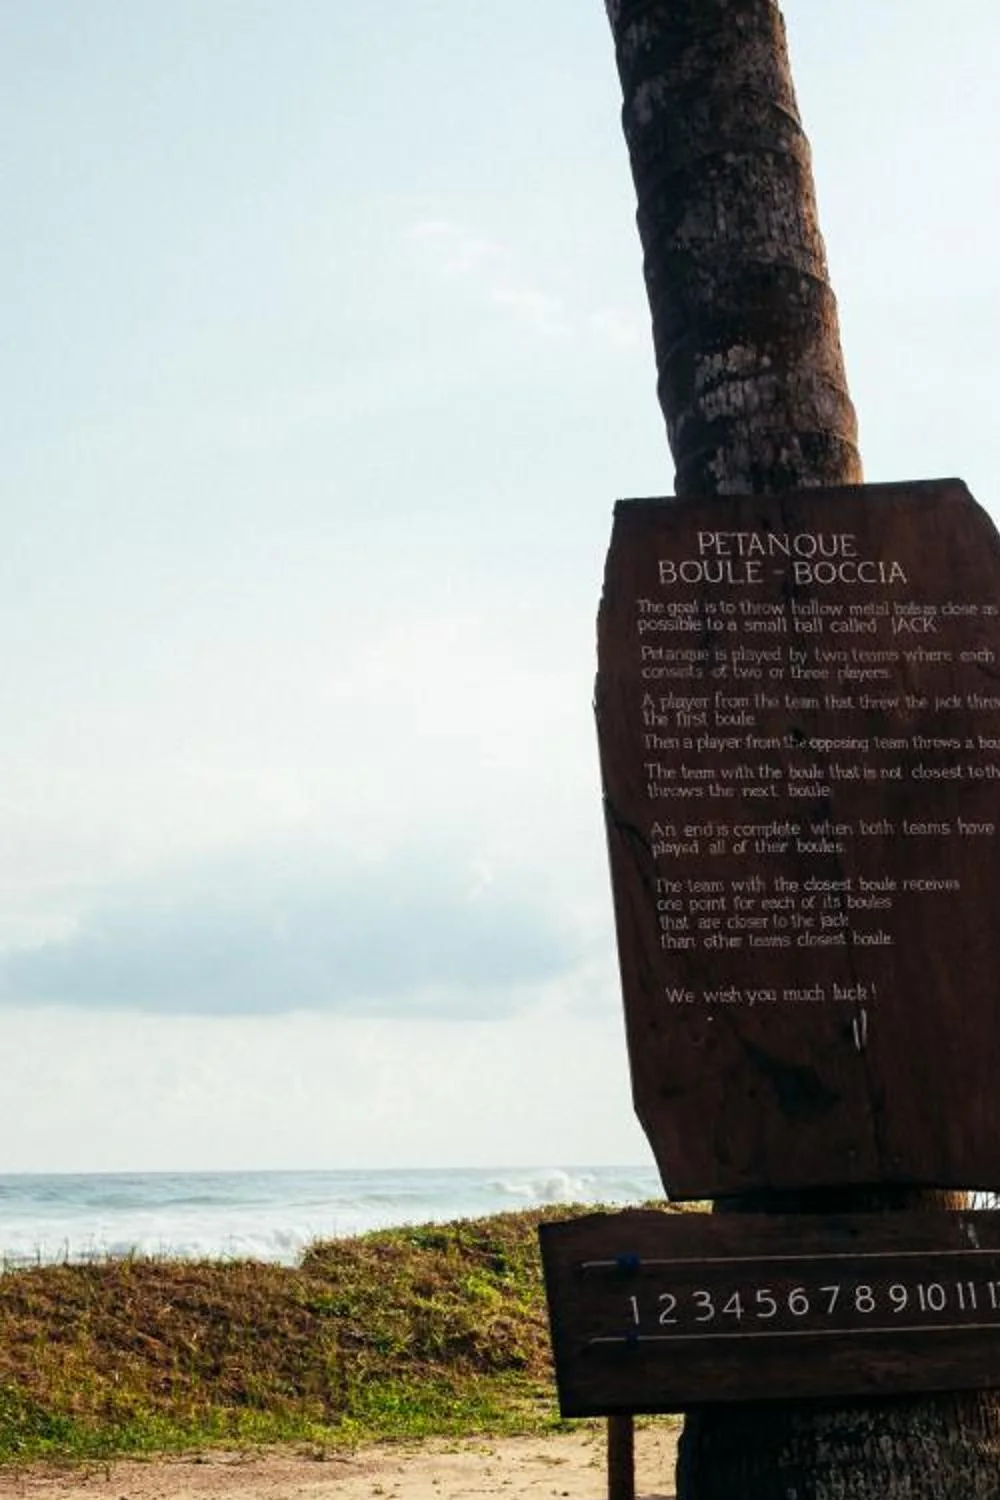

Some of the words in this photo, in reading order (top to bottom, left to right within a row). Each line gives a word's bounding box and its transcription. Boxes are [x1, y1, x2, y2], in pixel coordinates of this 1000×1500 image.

[697, 532, 860, 558] PETANQUE
[658, 560, 763, 584] BOULE
[793, 559, 907, 585] BOCCIA
[636, 599, 665, 613] The
[667, 599, 698, 617] goal
[705, 600, 717, 613] is
[720, 600, 737, 614] to
[739, 599, 784, 615] throw
[791, 598, 844, 616] hollow
[850, 601, 889, 616] metal
[941, 601, 978, 615] close
[636, 616, 701, 635] possible
[707, 616, 724, 632] to
[726, 620, 738, 632] a
[744, 617, 787, 633] small
[794, 617, 823, 633] ball
[829, 617, 877, 633] called
[641, 646, 709, 662] Petanque
[715, 647, 728, 661] is
[731, 645, 781, 665] played
[789, 646, 807, 665] by
[815, 647, 848, 662] two
[851, 648, 899, 662] teams
[903, 645, 953, 662] where
[960, 647, 996, 663] each
[712, 664, 729, 679] of
[733, 664, 763, 679] two
[769, 667, 784, 679] or
[791, 665, 829, 679] three
[640, 693, 655, 708] A
[660, 692, 709, 713] player
[715, 692, 749, 708] from
[754, 692, 780, 709] the
[785, 693, 820, 709] team
[825, 693, 855, 709] that
[859, 694, 899, 709] threw
[905, 694, 929, 709] the
[934, 694, 962, 713] jack
[642, 709, 669, 726] the
[676, 709, 708, 727] first
[643, 734, 679, 749] Then
[683, 737, 692, 749] a
[697, 732, 743, 752] player
[747, 733, 781, 749] from
[809, 735, 869, 752] opposing
[873, 736, 909, 749] team
[912, 736, 961, 749] throws
[965, 738, 975, 749] a
[643, 763, 677, 779] The
[681, 764, 715, 779] team
[720, 763, 754, 779] with
[759, 763, 783, 779] the
[788, 763, 824, 779] boule
[828, 763, 860, 780] that
[863, 764, 877, 779] is
[880, 766, 902, 779] not
[911, 763, 963, 780] closest
[967, 764, 984, 779] to
[647, 782, 703, 798] throws
[708, 783, 734, 797] the
[742, 784, 779, 797] next
[651, 820, 677, 837] An
[684, 820, 714, 837] end
[717, 823, 729, 837] is
[733, 820, 800, 839] complete
[810, 819, 852, 836] when
[859, 819, 894, 835] both
[903, 819, 950, 835] teams
[957, 816, 995, 836] have
[651, 840, 699, 859] played
[708, 839, 726, 855] all
[732, 839, 748, 854] of
[657, 878, 683, 893] The
[688, 879, 724, 892] team
[731, 874, 765, 893] with
[774, 875, 799, 893] the
[804, 874, 852, 891] closest
[858, 875, 897, 891] boule
[903, 878, 960, 891] receives
[657, 898, 683, 911] one
[689, 897, 726, 914] point
[733, 896, 756, 910] for
[761, 896, 795, 911] each
[801, 896, 816, 909] of
[659, 914, 689, 930] that
[698, 916, 721, 929] are
[727, 914, 768, 929] closer
[772, 913, 788, 929] to
[790, 914, 815, 929] the
[661, 932, 696, 949] than
[703, 931, 743, 949] other
[797, 931, 846, 947] closest
[665, 986, 695, 1004] We
[703, 985, 743, 1004] wish
[745, 988, 777, 1006] you
[783, 983, 825, 1001] much
[630, 1296, 640, 1325] 1
[659, 1293, 678, 1325] 2
[692, 1290, 715, 1322] 3
[722, 1289, 744, 1320] 4
[756, 1289, 777, 1317] 5
[788, 1287, 809, 1316] 6
[820, 1285, 840, 1314] 7
[855, 1285, 875, 1313] 8
[889, 1284, 908, 1313] 9
[917, 1282, 946, 1312] 10
[956, 1281, 978, 1310] 11
